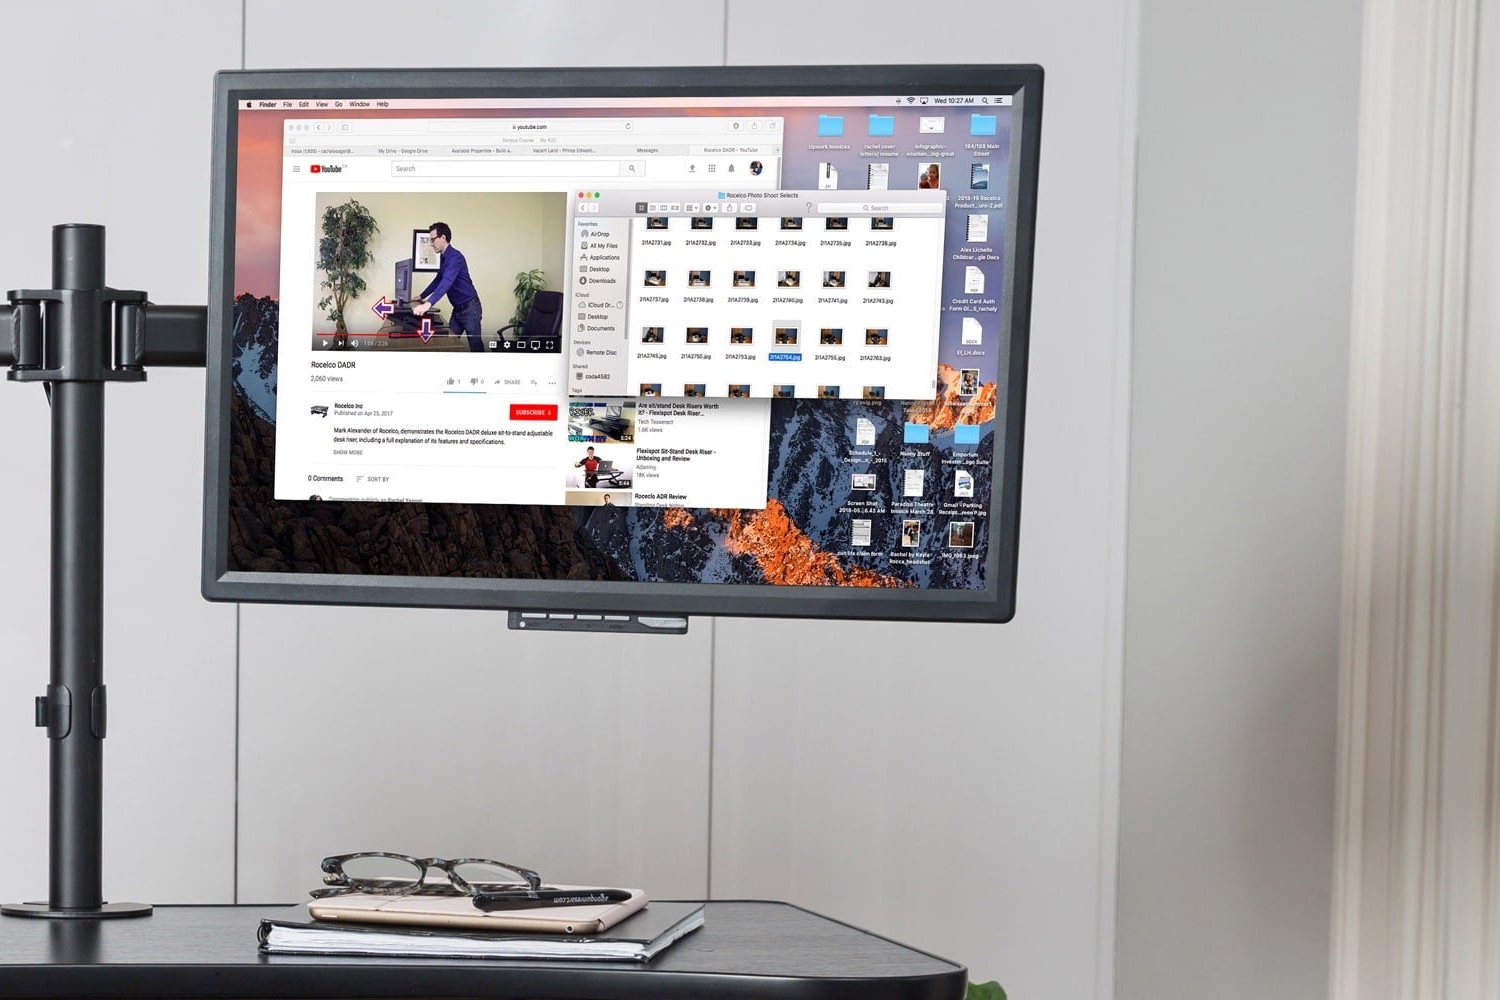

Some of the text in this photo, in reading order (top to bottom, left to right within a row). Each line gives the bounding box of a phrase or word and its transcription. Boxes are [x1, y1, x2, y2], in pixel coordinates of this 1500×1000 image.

[376, 101, 389, 109] Help
[320, 165, 342, 173] YouTube
[310, 375, 326, 383] 2,060
